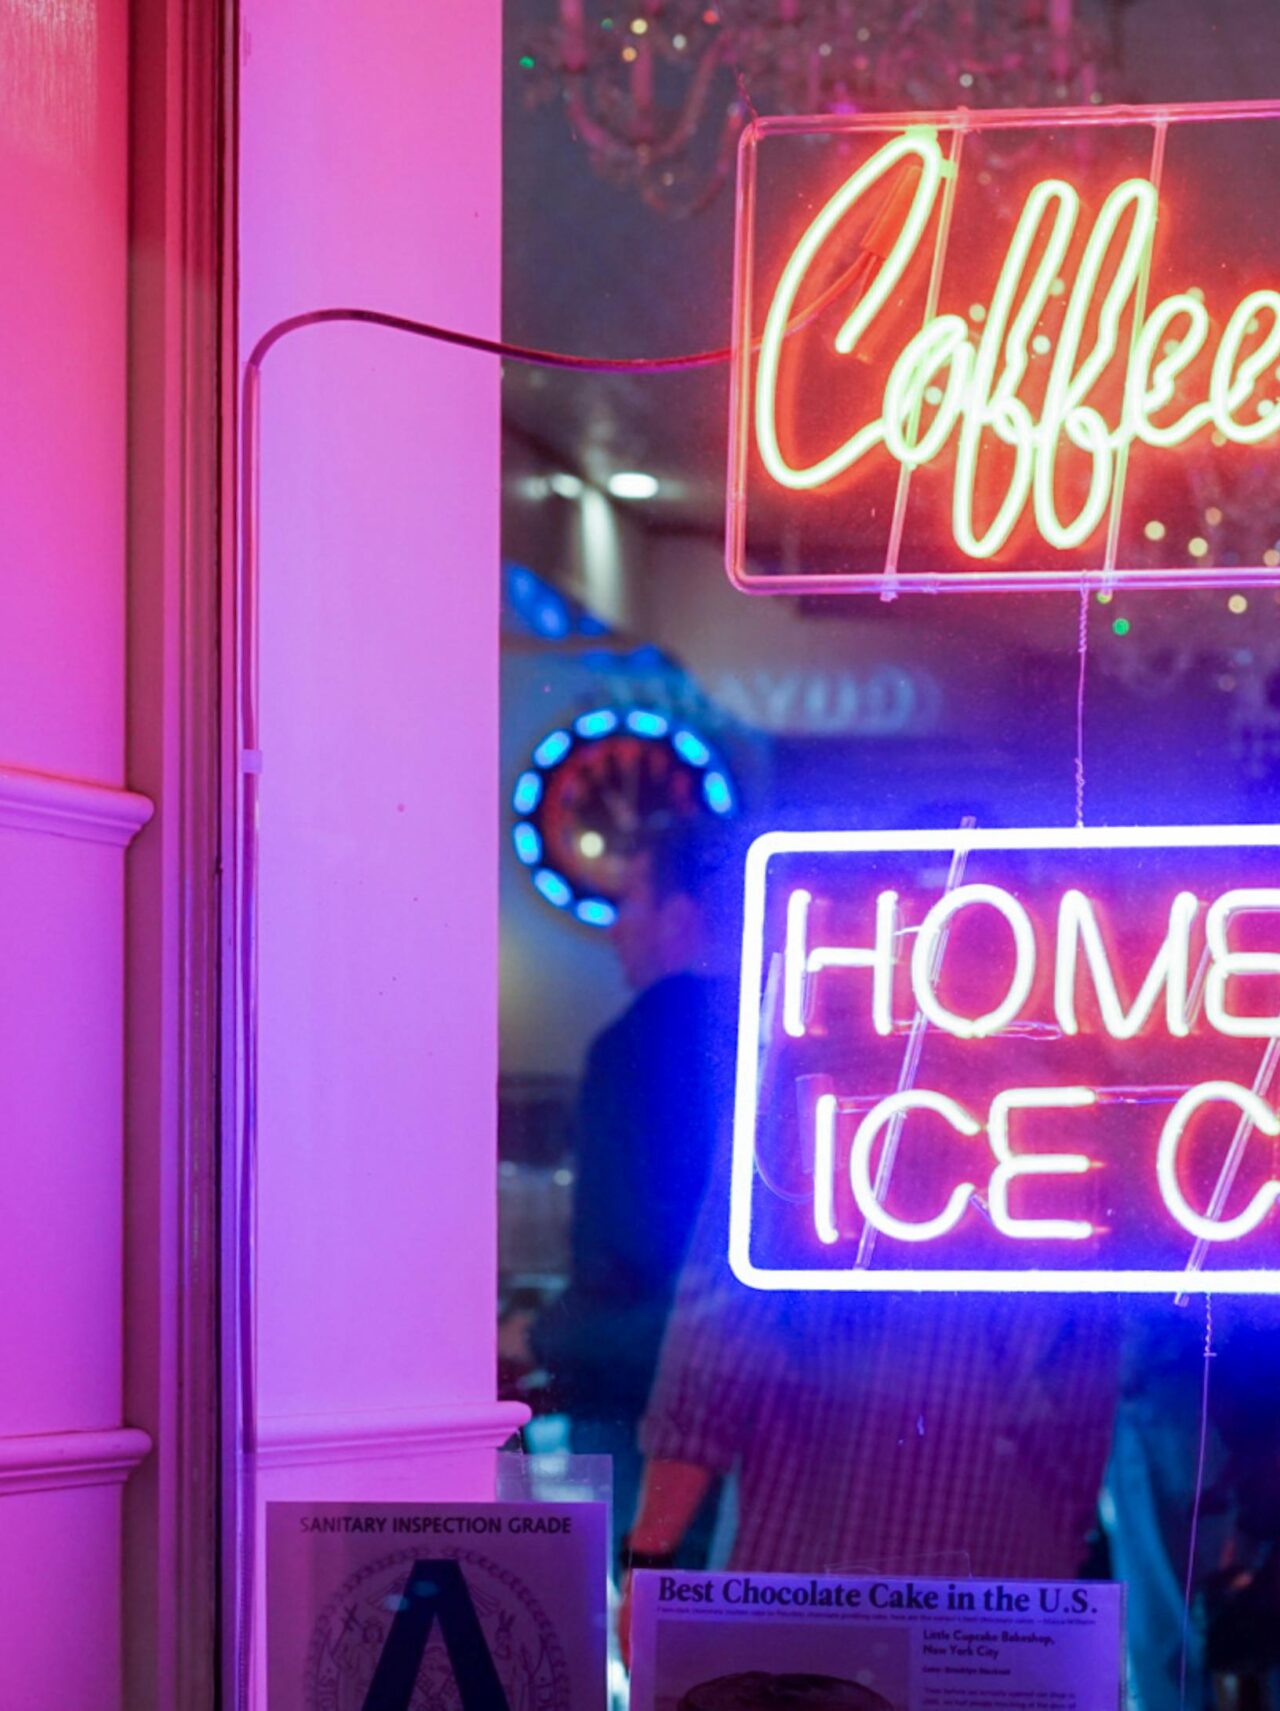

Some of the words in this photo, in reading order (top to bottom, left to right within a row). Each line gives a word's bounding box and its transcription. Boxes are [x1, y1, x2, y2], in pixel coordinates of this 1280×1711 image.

[814, 1085, 1097, 1246] ICE
[300, 1516, 386, 1535] SANITARY
[393, 1516, 501, 1534] INSPECTION
[508, 1516, 572, 1534] GRADE
[657, 1576, 714, 1603] Best
[722, 1577, 862, 1608] Chocolate
[868, 1582, 939, 1610] Cake
[946, 1583, 975, 1611] in
[983, 1584, 1031, 1613] the
[1039, 1587, 1099, 1615] U.S.
[922, 1628, 950, 1641] Little
[953, 1629, 998, 1646] Cupcake
[922, 1644, 946, 1655] New
[949, 1645, 973, 1656] York
[976, 1645, 999, 1660] City
